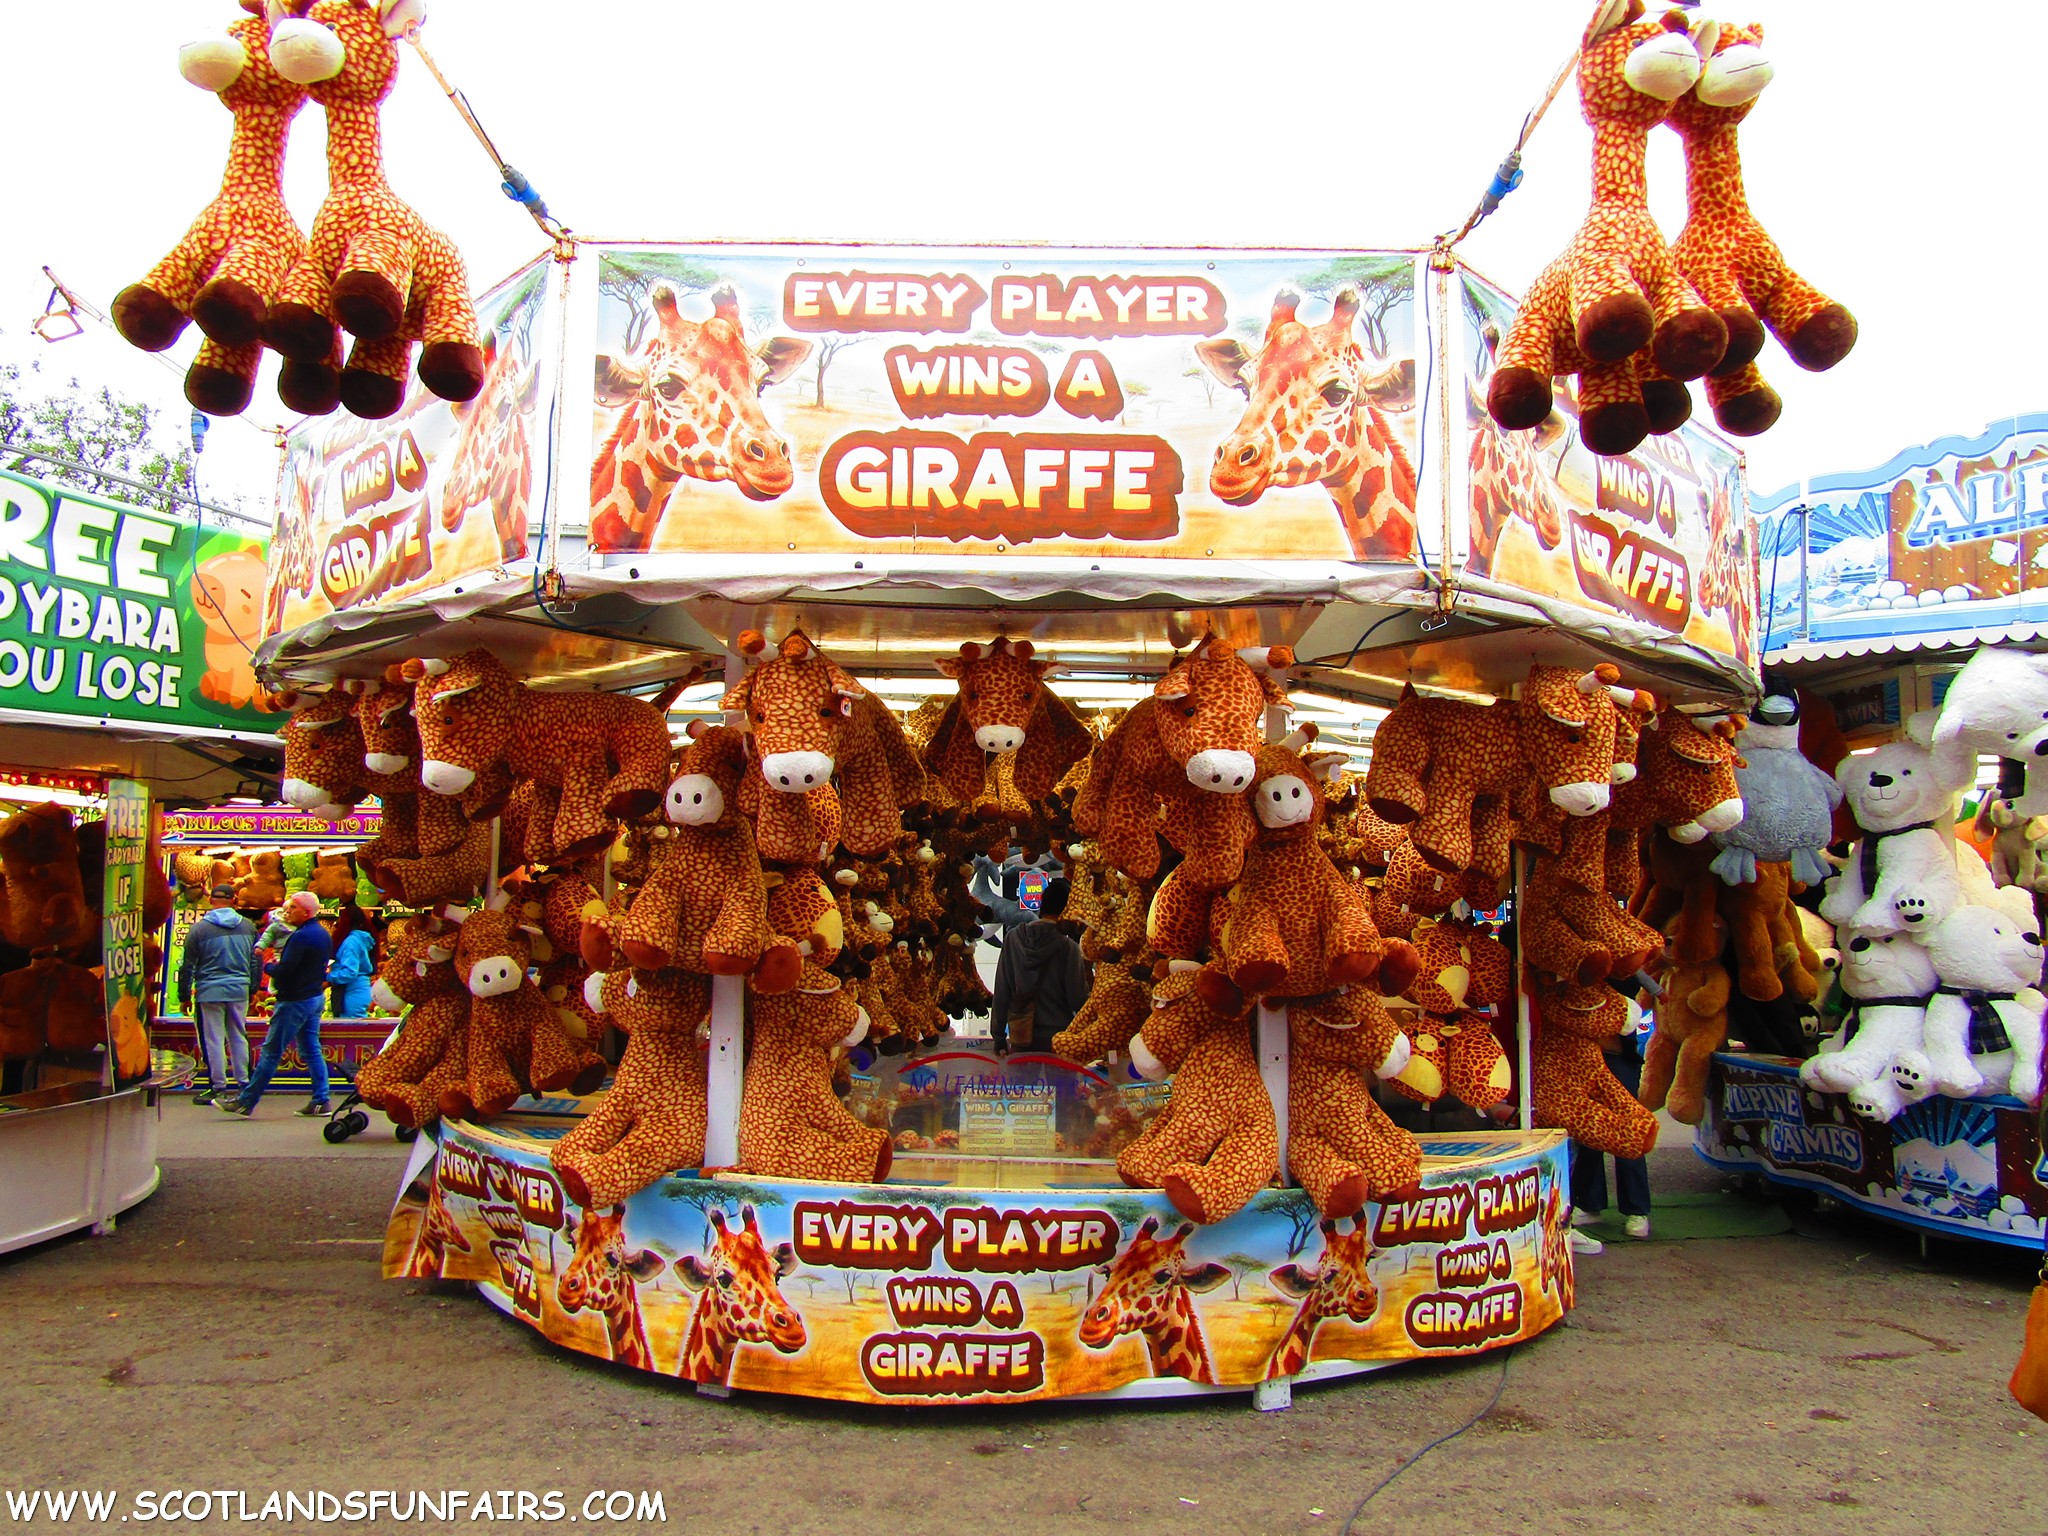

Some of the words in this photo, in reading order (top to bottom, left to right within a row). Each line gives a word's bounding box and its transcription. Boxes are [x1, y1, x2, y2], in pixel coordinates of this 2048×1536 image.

[793, 279, 969, 317] EVERY
[1001, 283, 1209, 323] PLAYER
[894, 353, 1032, 398] WINS
[1066, 357, 1106, 399] A
[343, 450, 387, 502] WINS
[400, 438, 420, 478] A
[834, 445, 1156, 512] GIRAFFE
[1598, 456, 1650, 508] WINS
[1659, 483, 1673, 519] A
[76, 651, 183, 709] LOSE
[108, 796, 146, 839] FREE
[162, 815, 257, 832] FABULOUS
[261, 815, 330, 833] PRIZES
[334, 818, 360, 833] TO
[107, 845, 145, 866] CAPYBARA
[118, 875, 132, 906] IF
[1025, 885, 1043, 893] WINS
[108, 913, 139, 942] YOU
[107, 945, 141, 979] LOSE
[909, 1072, 937, 1094] NO
[944, 1072, 1025, 1098] LEANING
[1724, 1086, 1801, 1118] ALPINE
[965, 1103, 991, 1113] WINS
[995, 1103, 1004, 1113] A
[1008, 1103, 1050, 1113] GIRAFFE
[1771, 1123, 1859, 1162] GAMES
[440, 1147, 481, 1188] EVERY
[481, 1209, 523, 1234] WINS
[1380, 1193, 1466, 1233] EVERY
[1478, 1175, 1536, 1221] PLAYER
[802, 1211, 928, 1252] EVERY
[952, 1218, 1106, 1255] PLAYER
[1442, 1250, 1488, 1278] WINS
[1494, 1243, 1507, 1269] A
[893, 1284, 971, 1314] WINS
[991, 1288, 1014, 1315] A
[1412, 1291, 1516, 1333] GIRAFFE
[869, 1341, 1031, 1379] GIRAFFE
